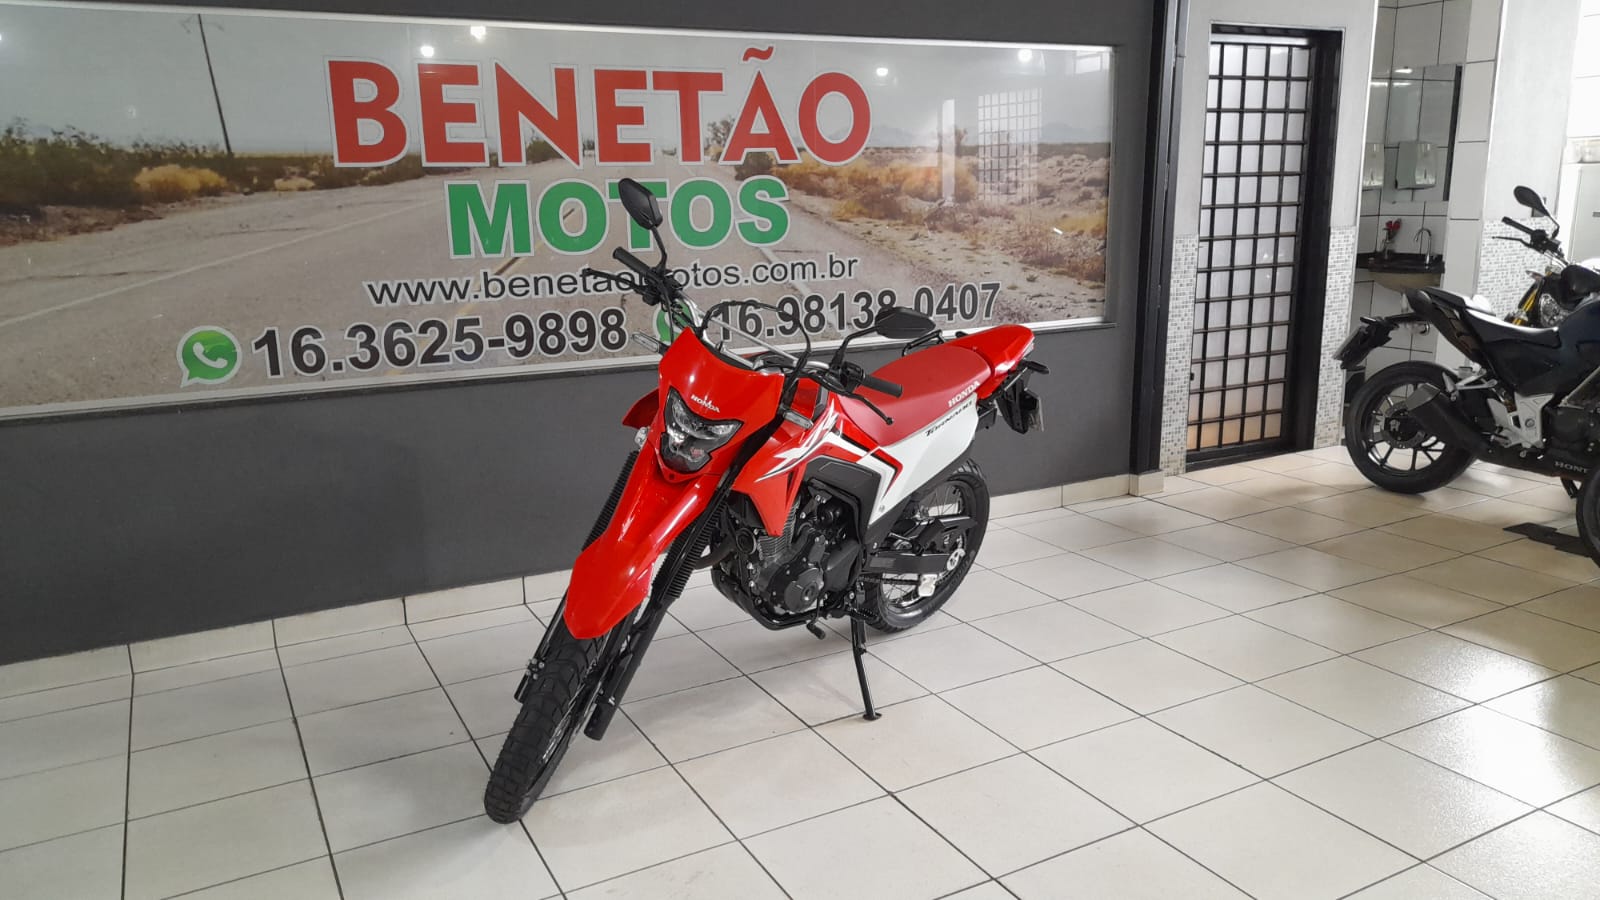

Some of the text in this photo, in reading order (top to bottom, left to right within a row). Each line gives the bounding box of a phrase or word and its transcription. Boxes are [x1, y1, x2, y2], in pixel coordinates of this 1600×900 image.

[327, 46, 872, 168] BENETÃO
[446, 176, 790, 257] MOTOS
[367, 255, 858, 304] www.benetaootos.com.br
[253, 308, 627, 376] 16.3625-9898
[690, 394, 720, 413] HONDA
[947, 380, 980, 407] HONDA
